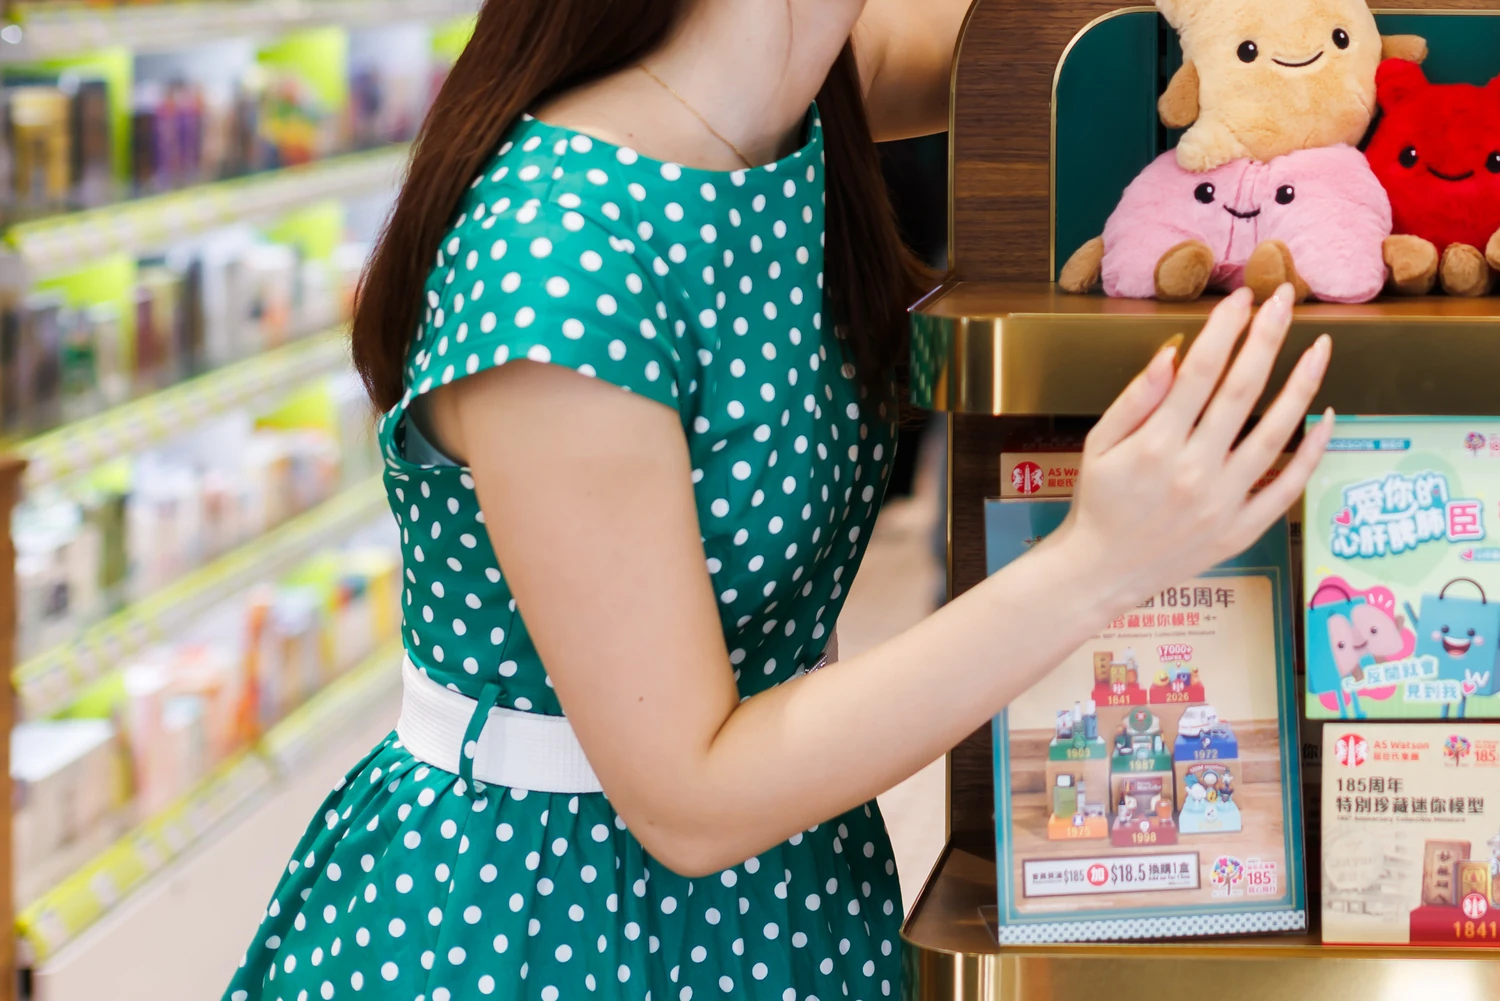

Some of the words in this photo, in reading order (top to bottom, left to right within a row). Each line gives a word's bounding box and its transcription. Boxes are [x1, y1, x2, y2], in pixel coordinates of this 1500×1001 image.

[1047, 468, 1062, 476] AS
[1106, 612, 1200, 629] 珍藏迷你模型
[1464, 668, 1490, 688] W
[1166, 692, 1190, 702] 2026
[1373, 741, 1388, 750] AS
[1390, 741, 1430, 750] Watson
[1193, 749, 1218, 760] 1972
[1474, 750, 1496, 762] 185
[1336, 777, 1404, 793] 185周年
[1336, 796, 1485, 814] 特別珍藏迷你模型
[1132, 832, 1157, 843] 1998
[1064, 868, 1085, 883] $185
[1091, 866, 1106, 883] 加
[1111, 862, 1146, 884] $18.5
[1246, 871, 1271, 885] 185
[1453, 921, 1497, 939] 1841
